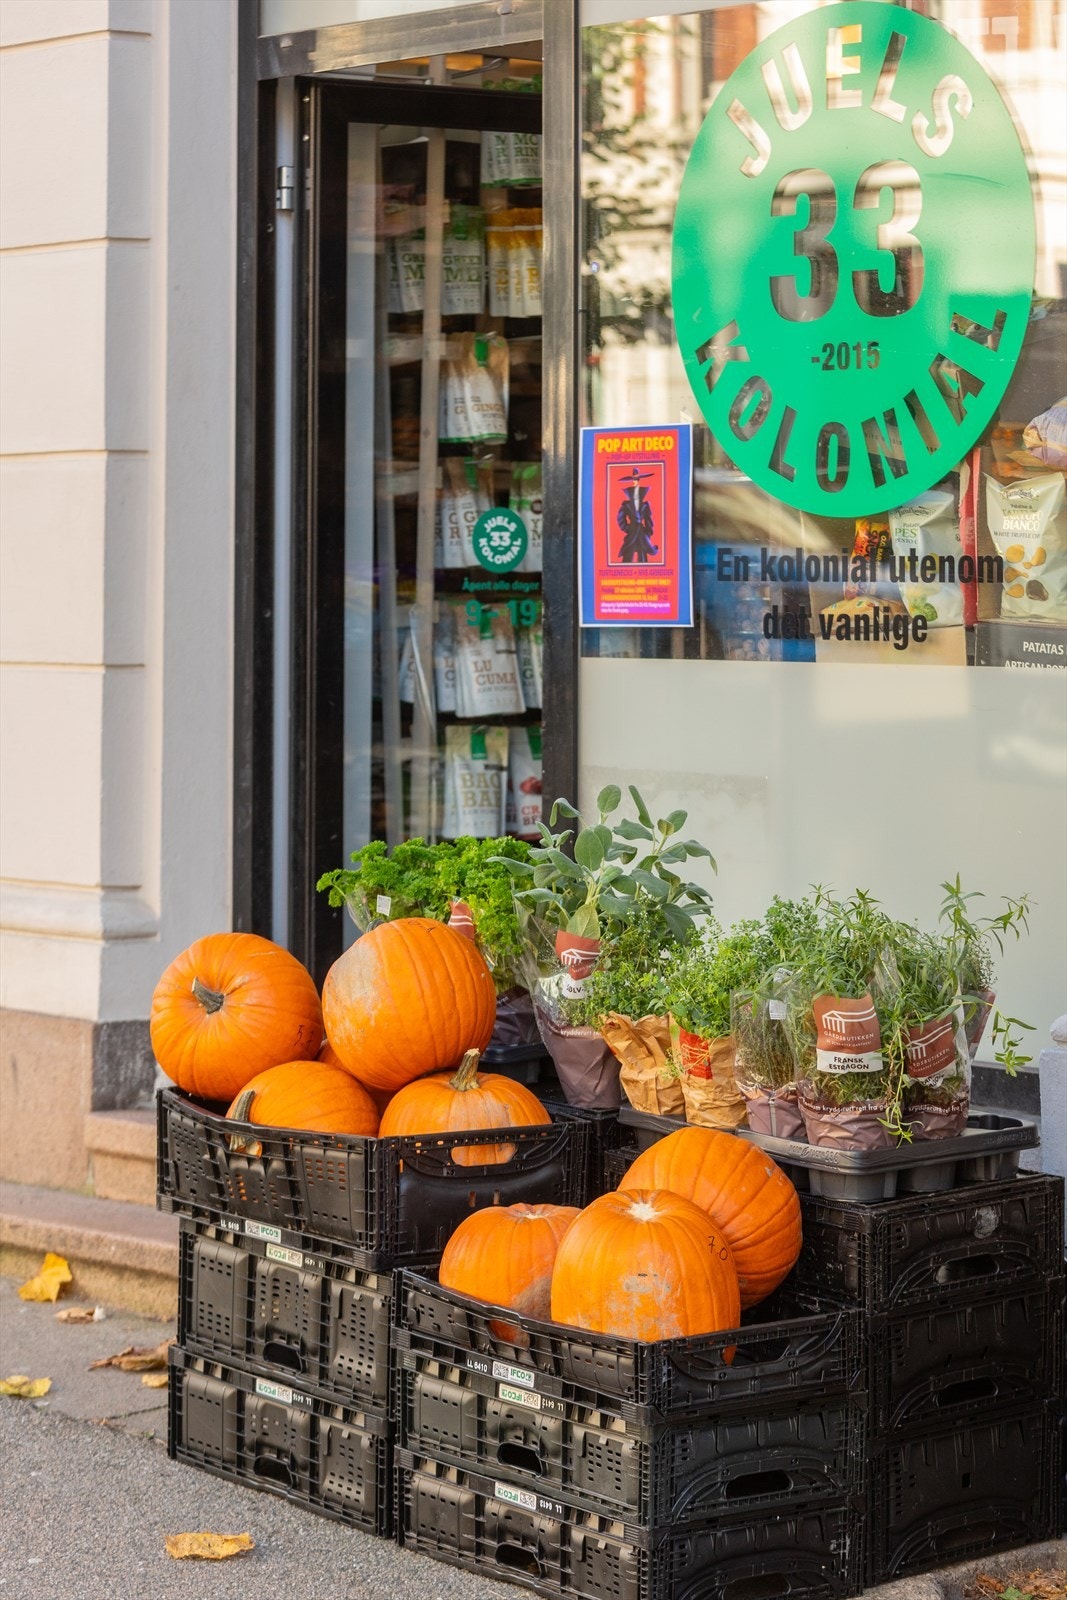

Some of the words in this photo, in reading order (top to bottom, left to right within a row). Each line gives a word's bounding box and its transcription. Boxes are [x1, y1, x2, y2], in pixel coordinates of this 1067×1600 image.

[726, 24, 973, 178] JUELS
[769, 159, 925, 323] 33
[811, 341, 881, 371] -2015
[695, 308, 1008, 494] KOLONIAL
[598, 438, 621, 453] POP
[621, 437, 644, 452] ART
[645, 436, 674, 451] DECO
[484, 516, 518, 533] JUELS
[1003, 519, 1041, 531] BIANCO
[490, 531, 511, 547] 33
[478, 537, 522, 565] KOLONIAL
[717, 547, 749, 582] En
[760, 547, 877, 582] kolonial
[890, 547, 1005, 584] utenom
[493, 581, 511, 590] alle
[465, 599, 482, 626] 9
[506, 599, 537, 626] 19
[763, 605, 815, 645] det
[819, 605, 928, 651] vanlige
[1023, 641, 1064, 655] PATATAS
[833, 1056, 864, 1064] FRANSK
[260, 1226, 274, 1237] IFCO
[274, 1250, 287, 1261] IFCO
[467, 1359, 474, 1369] LL
[474, 1361, 488, 1373] 6410
[510, 1367, 525, 1380] IFCO
[507, 1391, 522, 1403] IFCO
[503, 1490, 519, 1502] IFCO
[555, 1504, 562, 1514] LL
